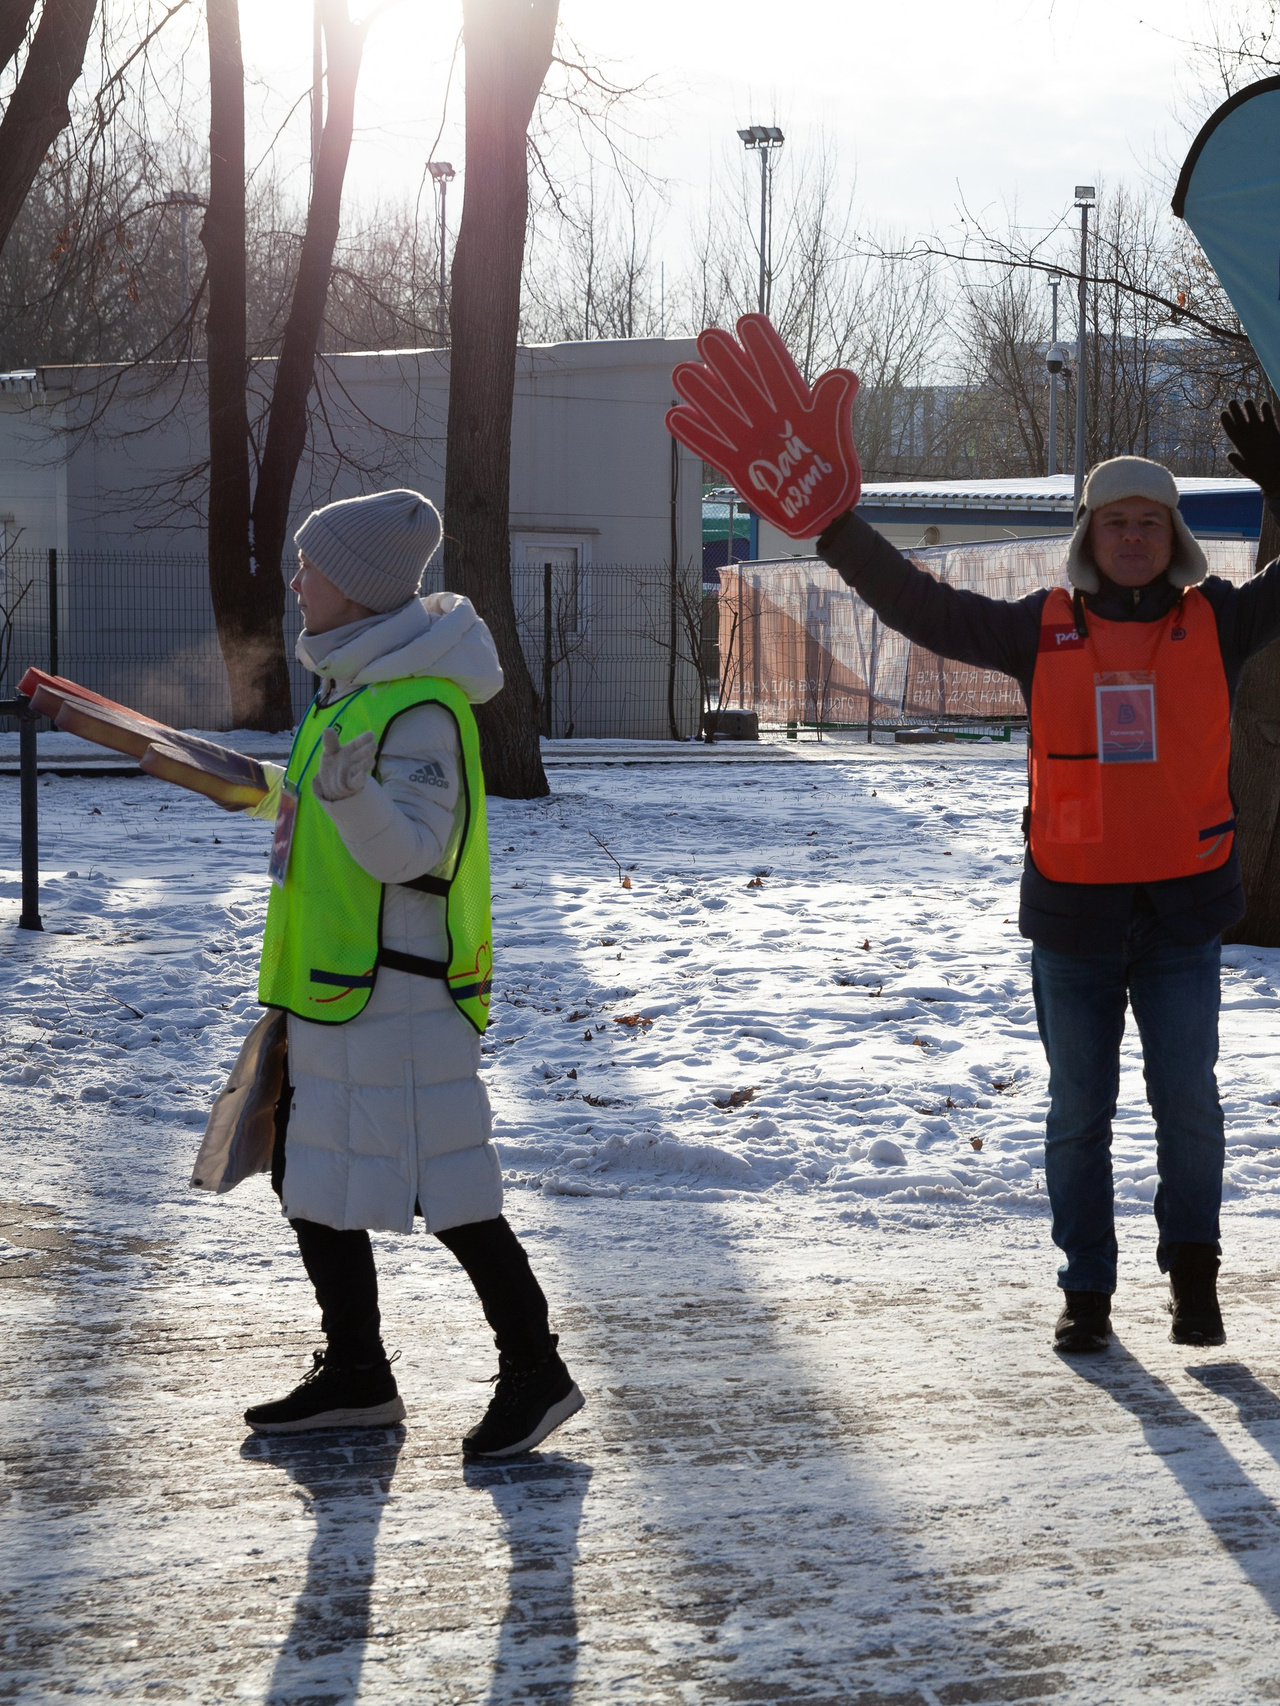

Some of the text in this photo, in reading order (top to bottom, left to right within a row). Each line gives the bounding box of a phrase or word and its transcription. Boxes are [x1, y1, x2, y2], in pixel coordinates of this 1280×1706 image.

[748, 420, 813, 499] Дай
[779, 454, 834, 519] пять
[951, 671, 979, 686] ДЛЯ
[979, 689, 1021, 705] КАЖД
[408, 772, 450, 790] adidas
